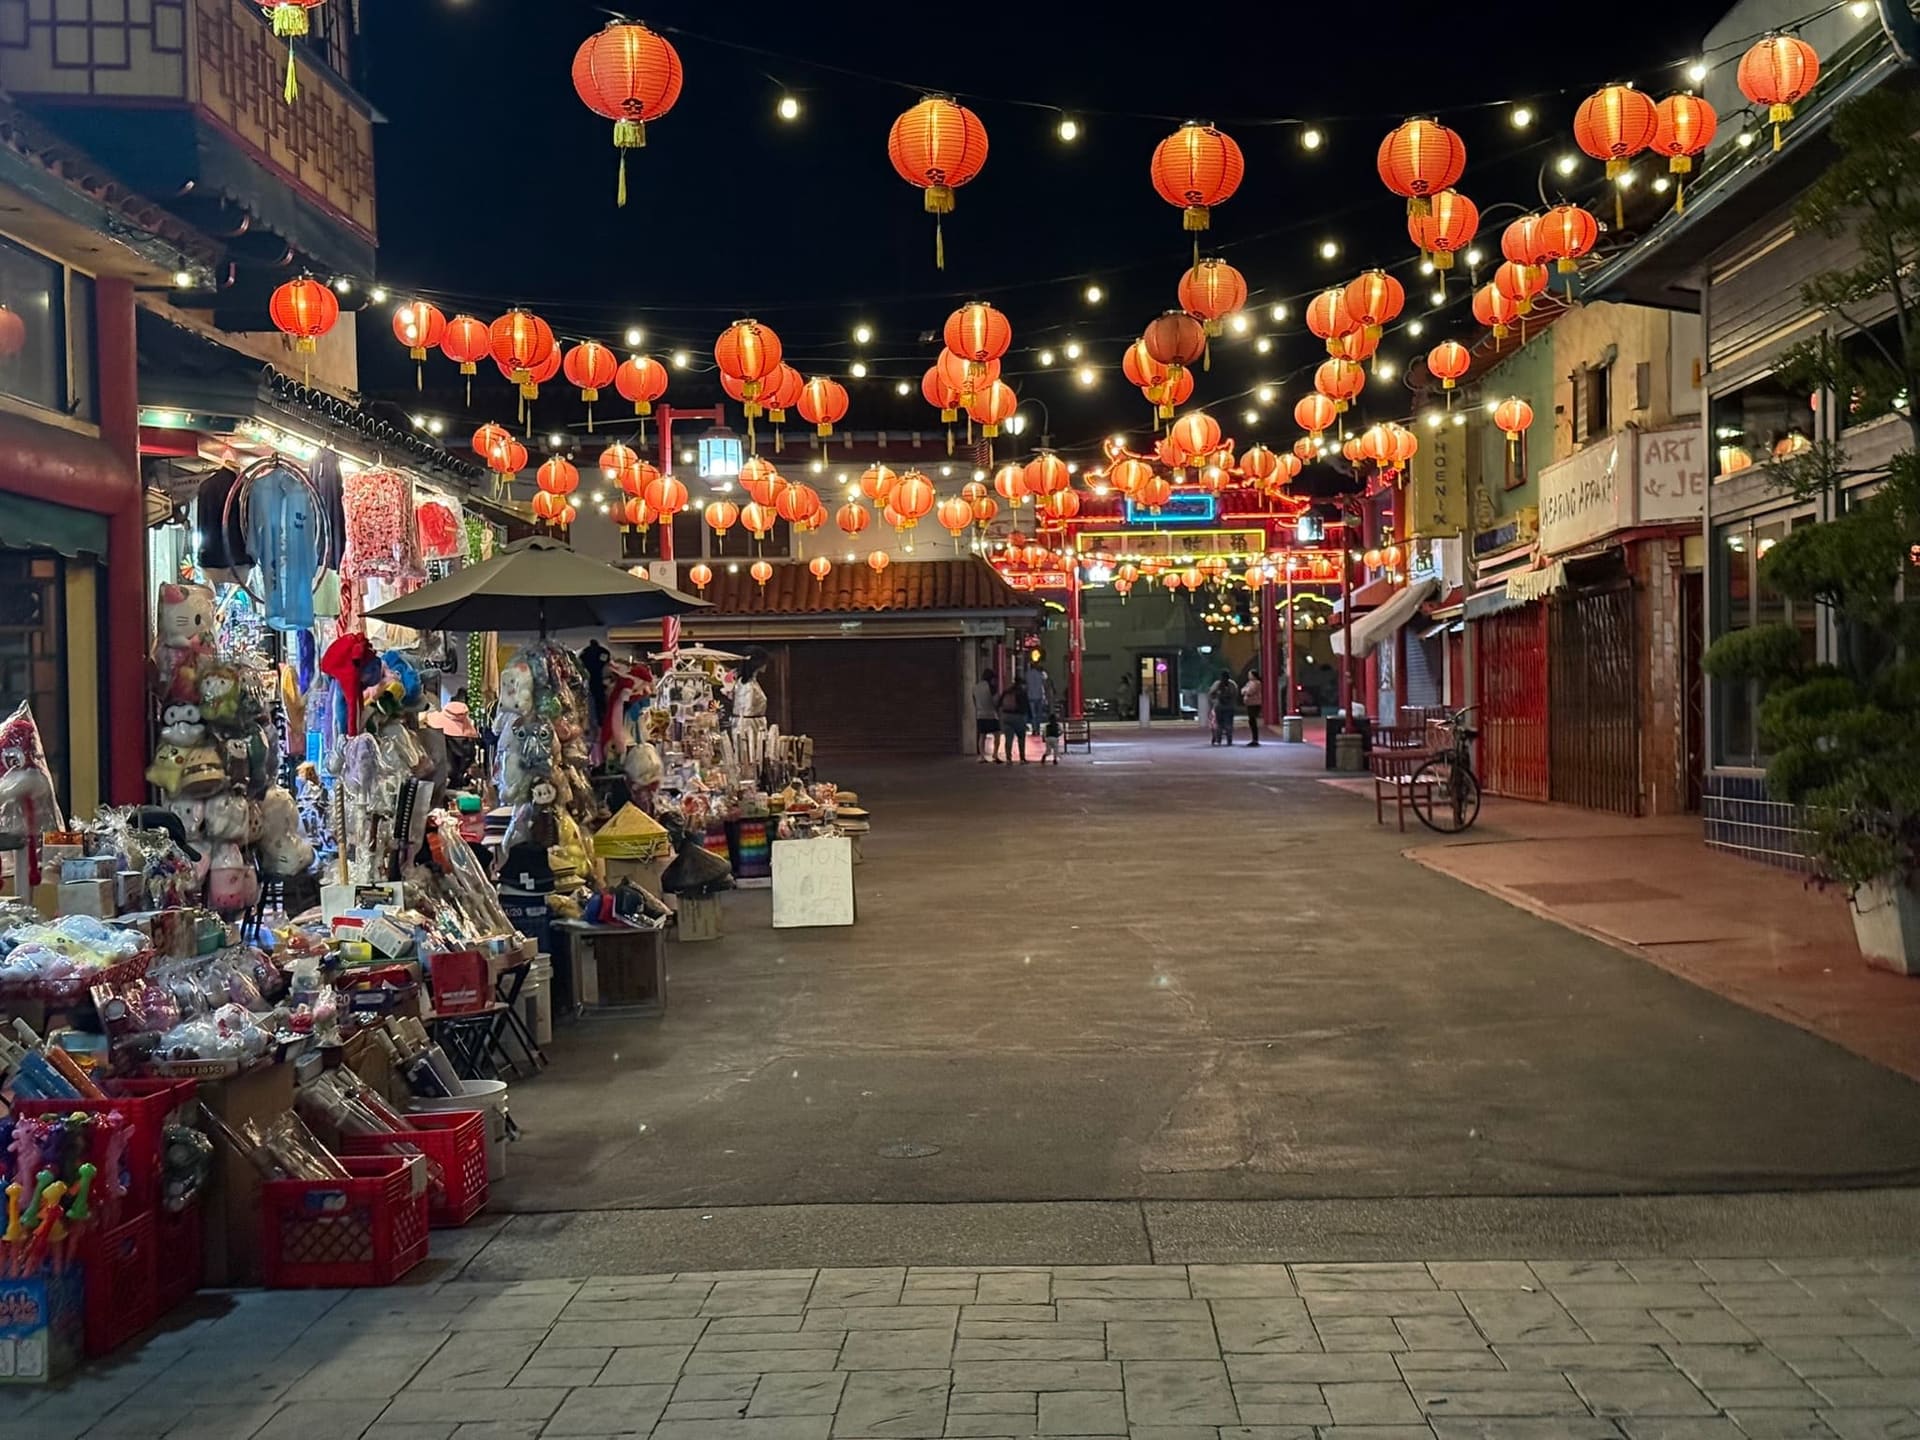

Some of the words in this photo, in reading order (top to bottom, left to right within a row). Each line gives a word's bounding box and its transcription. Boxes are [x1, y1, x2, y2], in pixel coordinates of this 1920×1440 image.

[1644, 436, 1696, 465] ART
[1644, 478, 1666, 498] &
[1541, 487, 1576, 528] WEARING
